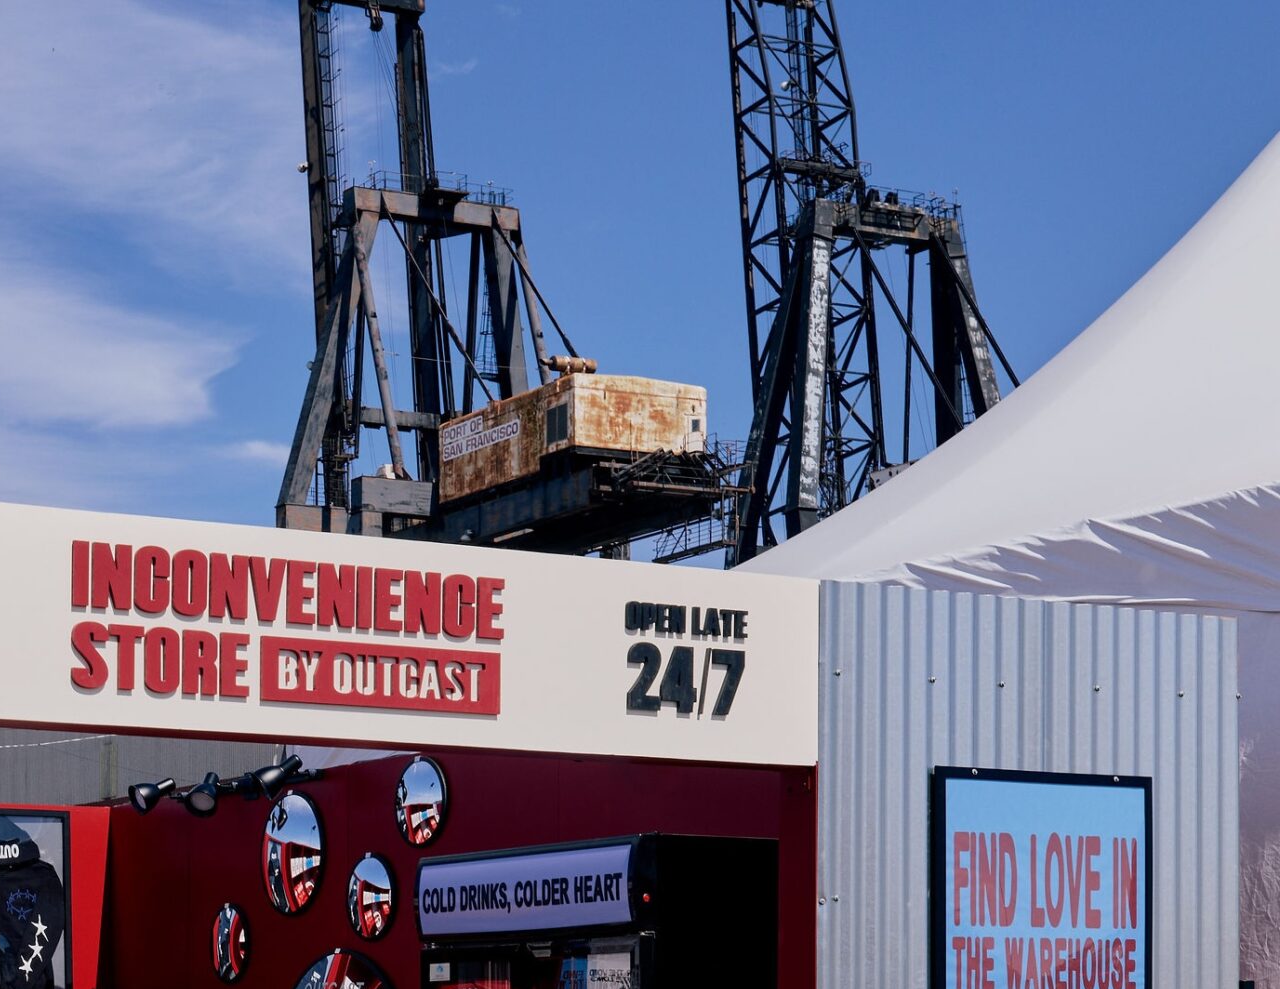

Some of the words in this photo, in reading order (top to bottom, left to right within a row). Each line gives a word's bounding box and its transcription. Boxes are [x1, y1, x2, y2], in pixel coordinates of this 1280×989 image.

[444, 422, 468, 442] PORT
[470, 417, 482, 433] OF
[444, 442, 463, 459] SAN
[466, 421, 519, 452] FRANCISCO
[71, 539, 506, 641] INCONVENIENCE
[624, 600, 687, 635] OPEN
[690, 606, 749, 639] LATE
[71, 621, 251, 698] STORE
[277, 648, 323, 692] BY
[332, 651, 487, 703] OUTCAST
[626, 642, 746, 718] 24/7
[422, 886, 456, 914] COLD
[459, 882, 511, 914] DRINKS,
[514, 876, 570, 908] COLDER
[574, 872, 623, 904] HEART
[953, 831, 1018, 927] FIND
[1030, 831, 1101, 928] LOVE
[1112, 837, 1137, 929] IN
